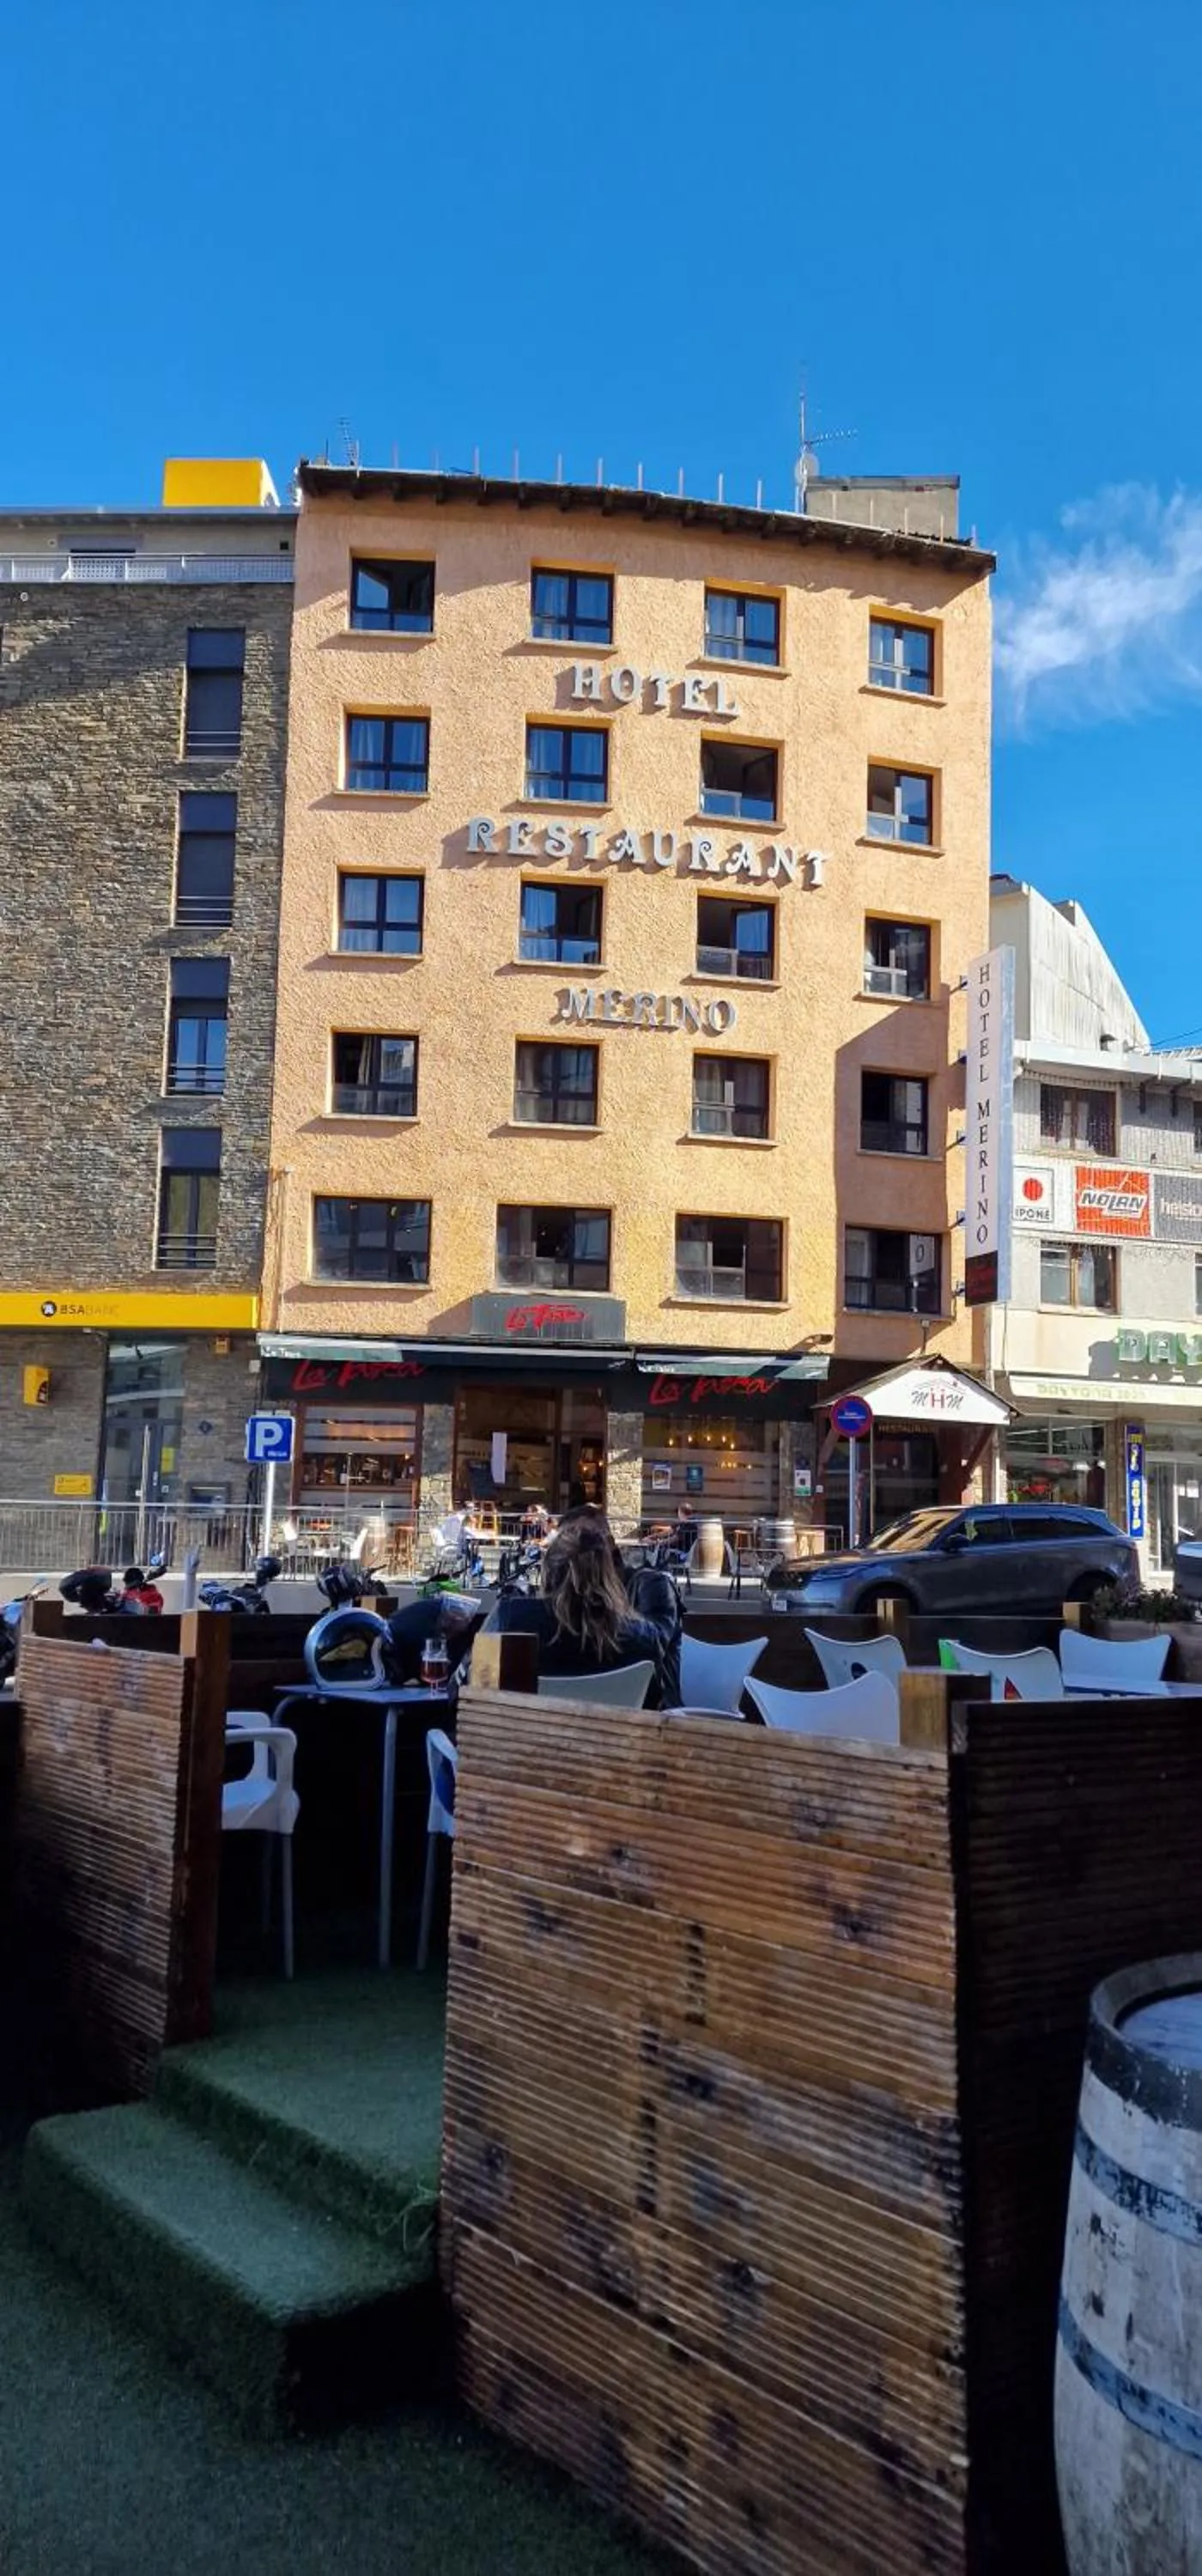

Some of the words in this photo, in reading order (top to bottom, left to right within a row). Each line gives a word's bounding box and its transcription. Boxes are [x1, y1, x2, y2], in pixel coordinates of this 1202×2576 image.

[571, 662, 741, 718] HOTEL
[466, 817, 833, 886] RESTAURANT
[562, 985, 738, 1033] MERINO
[978, 963, 990, 1082] HOTEL
[977, 1099, 990, 1244] MERINO
[1015, 1208, 1050, 1220] IPONE
[1081, 1191, 1144, 1212] NOLAN
[256, 1421, 283, 1457] P
